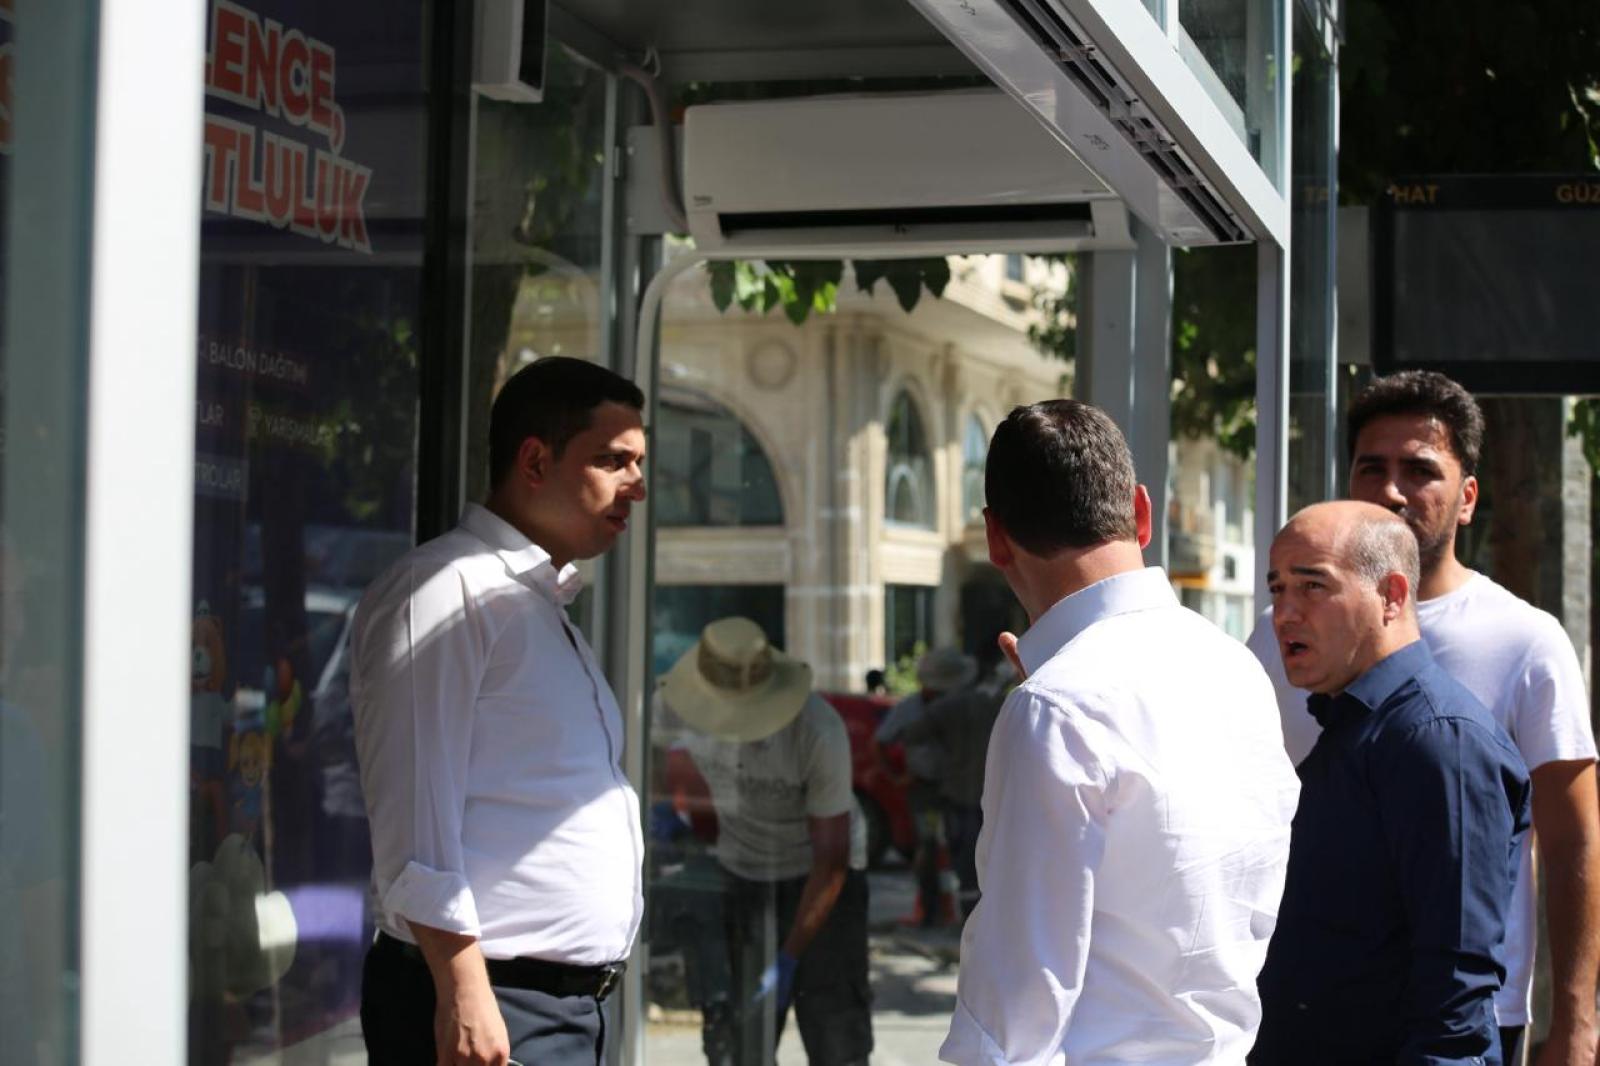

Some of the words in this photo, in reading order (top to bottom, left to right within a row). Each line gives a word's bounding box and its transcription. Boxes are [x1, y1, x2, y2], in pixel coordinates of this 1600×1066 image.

[204, 0, 345, 154] ENCE,
[1392, 184, 1440, 204] HAT
[208, 341, 256, 373] BALON
